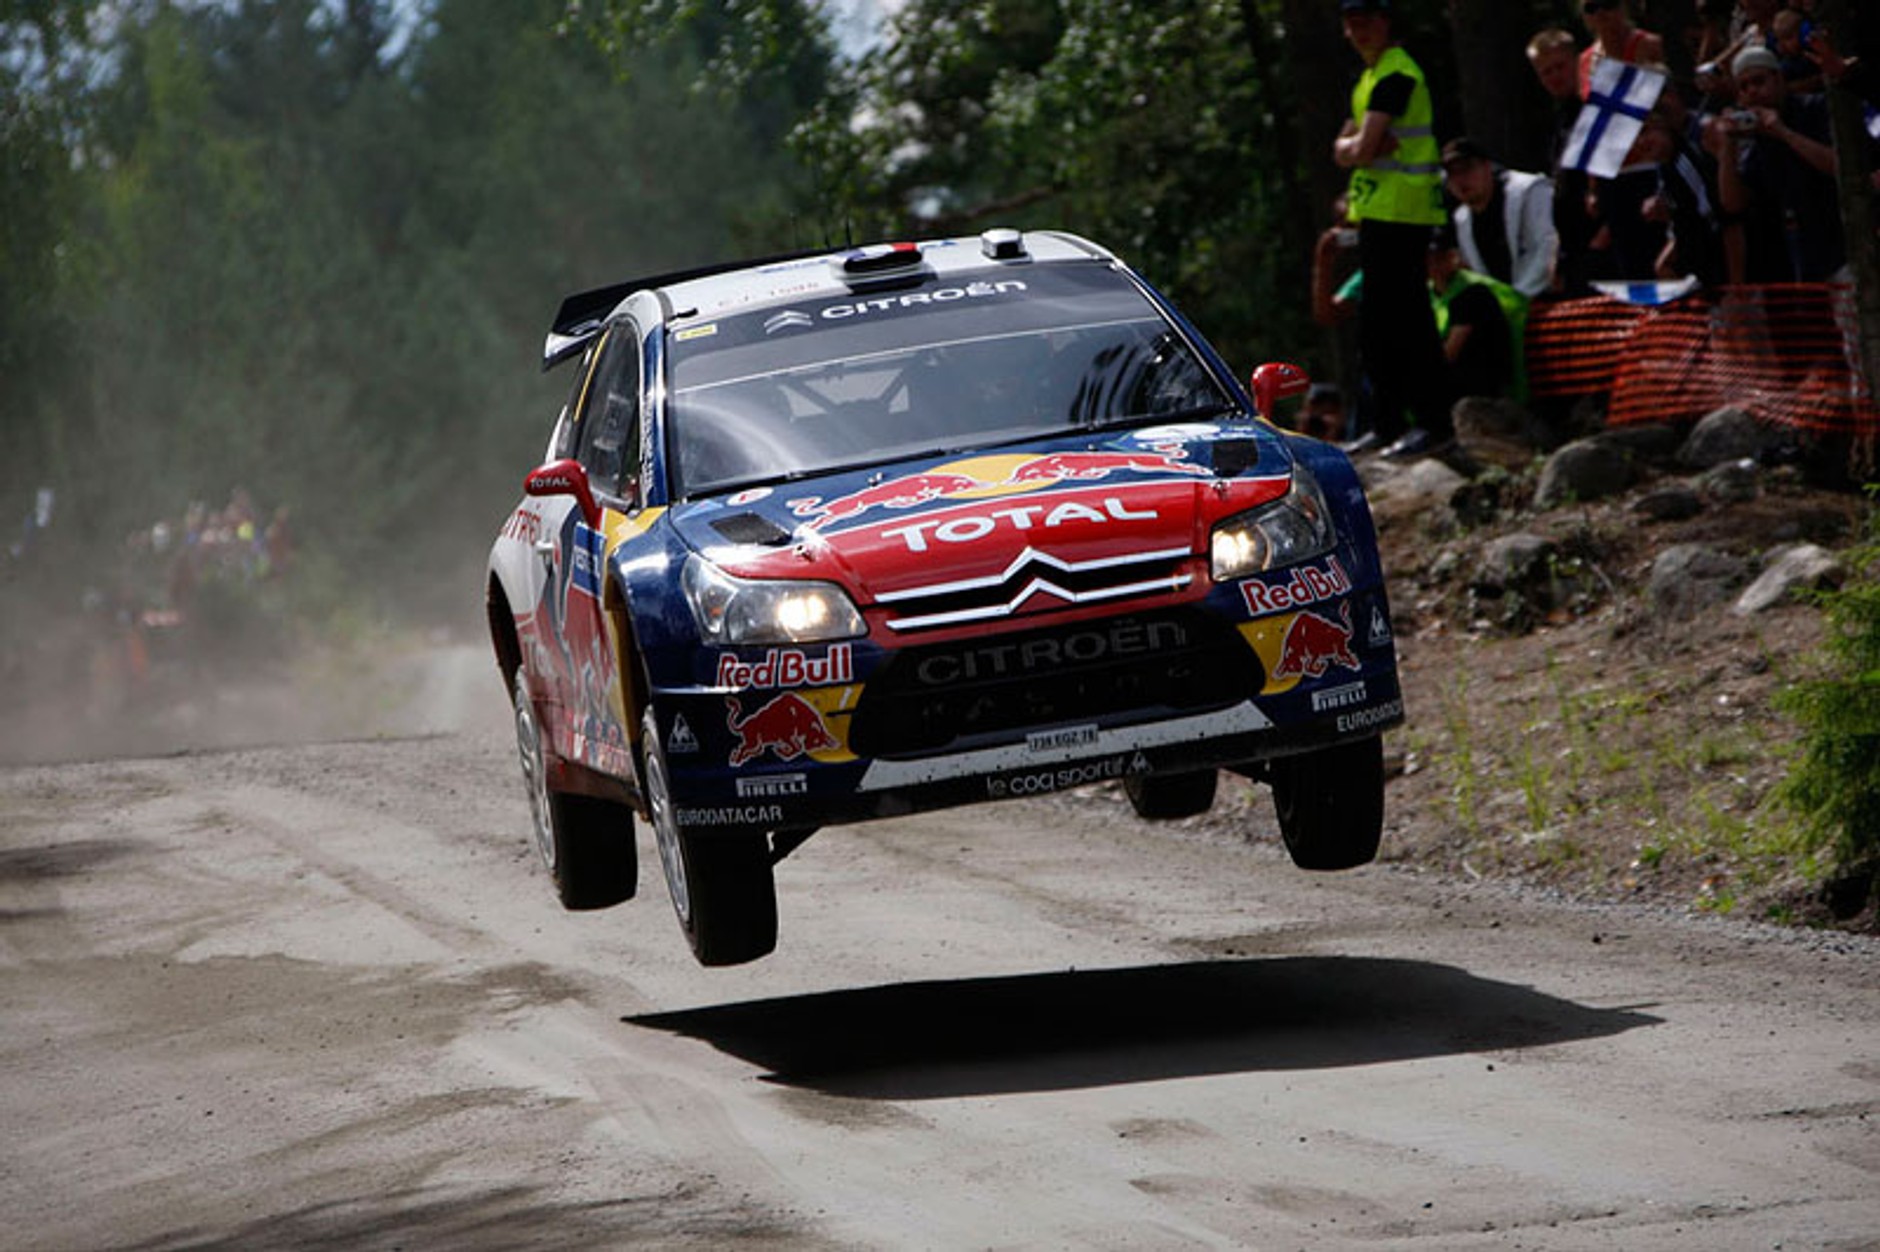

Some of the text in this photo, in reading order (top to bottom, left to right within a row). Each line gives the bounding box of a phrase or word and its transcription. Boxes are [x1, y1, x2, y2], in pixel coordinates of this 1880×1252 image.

[529, 476, 571, 490] TOTAL
[881, 498, 1158, 552] TOTAL
[1239, 567, 1314, 616] Red
[717, 643, 853, 688] Red Bull
[1311, 681, 1367, 712] PIRELLI
[736, 773, 807, 797] PIRELLI
[986, 757, 1124, 797] le coq sportif
[677, 805, 782, 825] EURODATACAR
